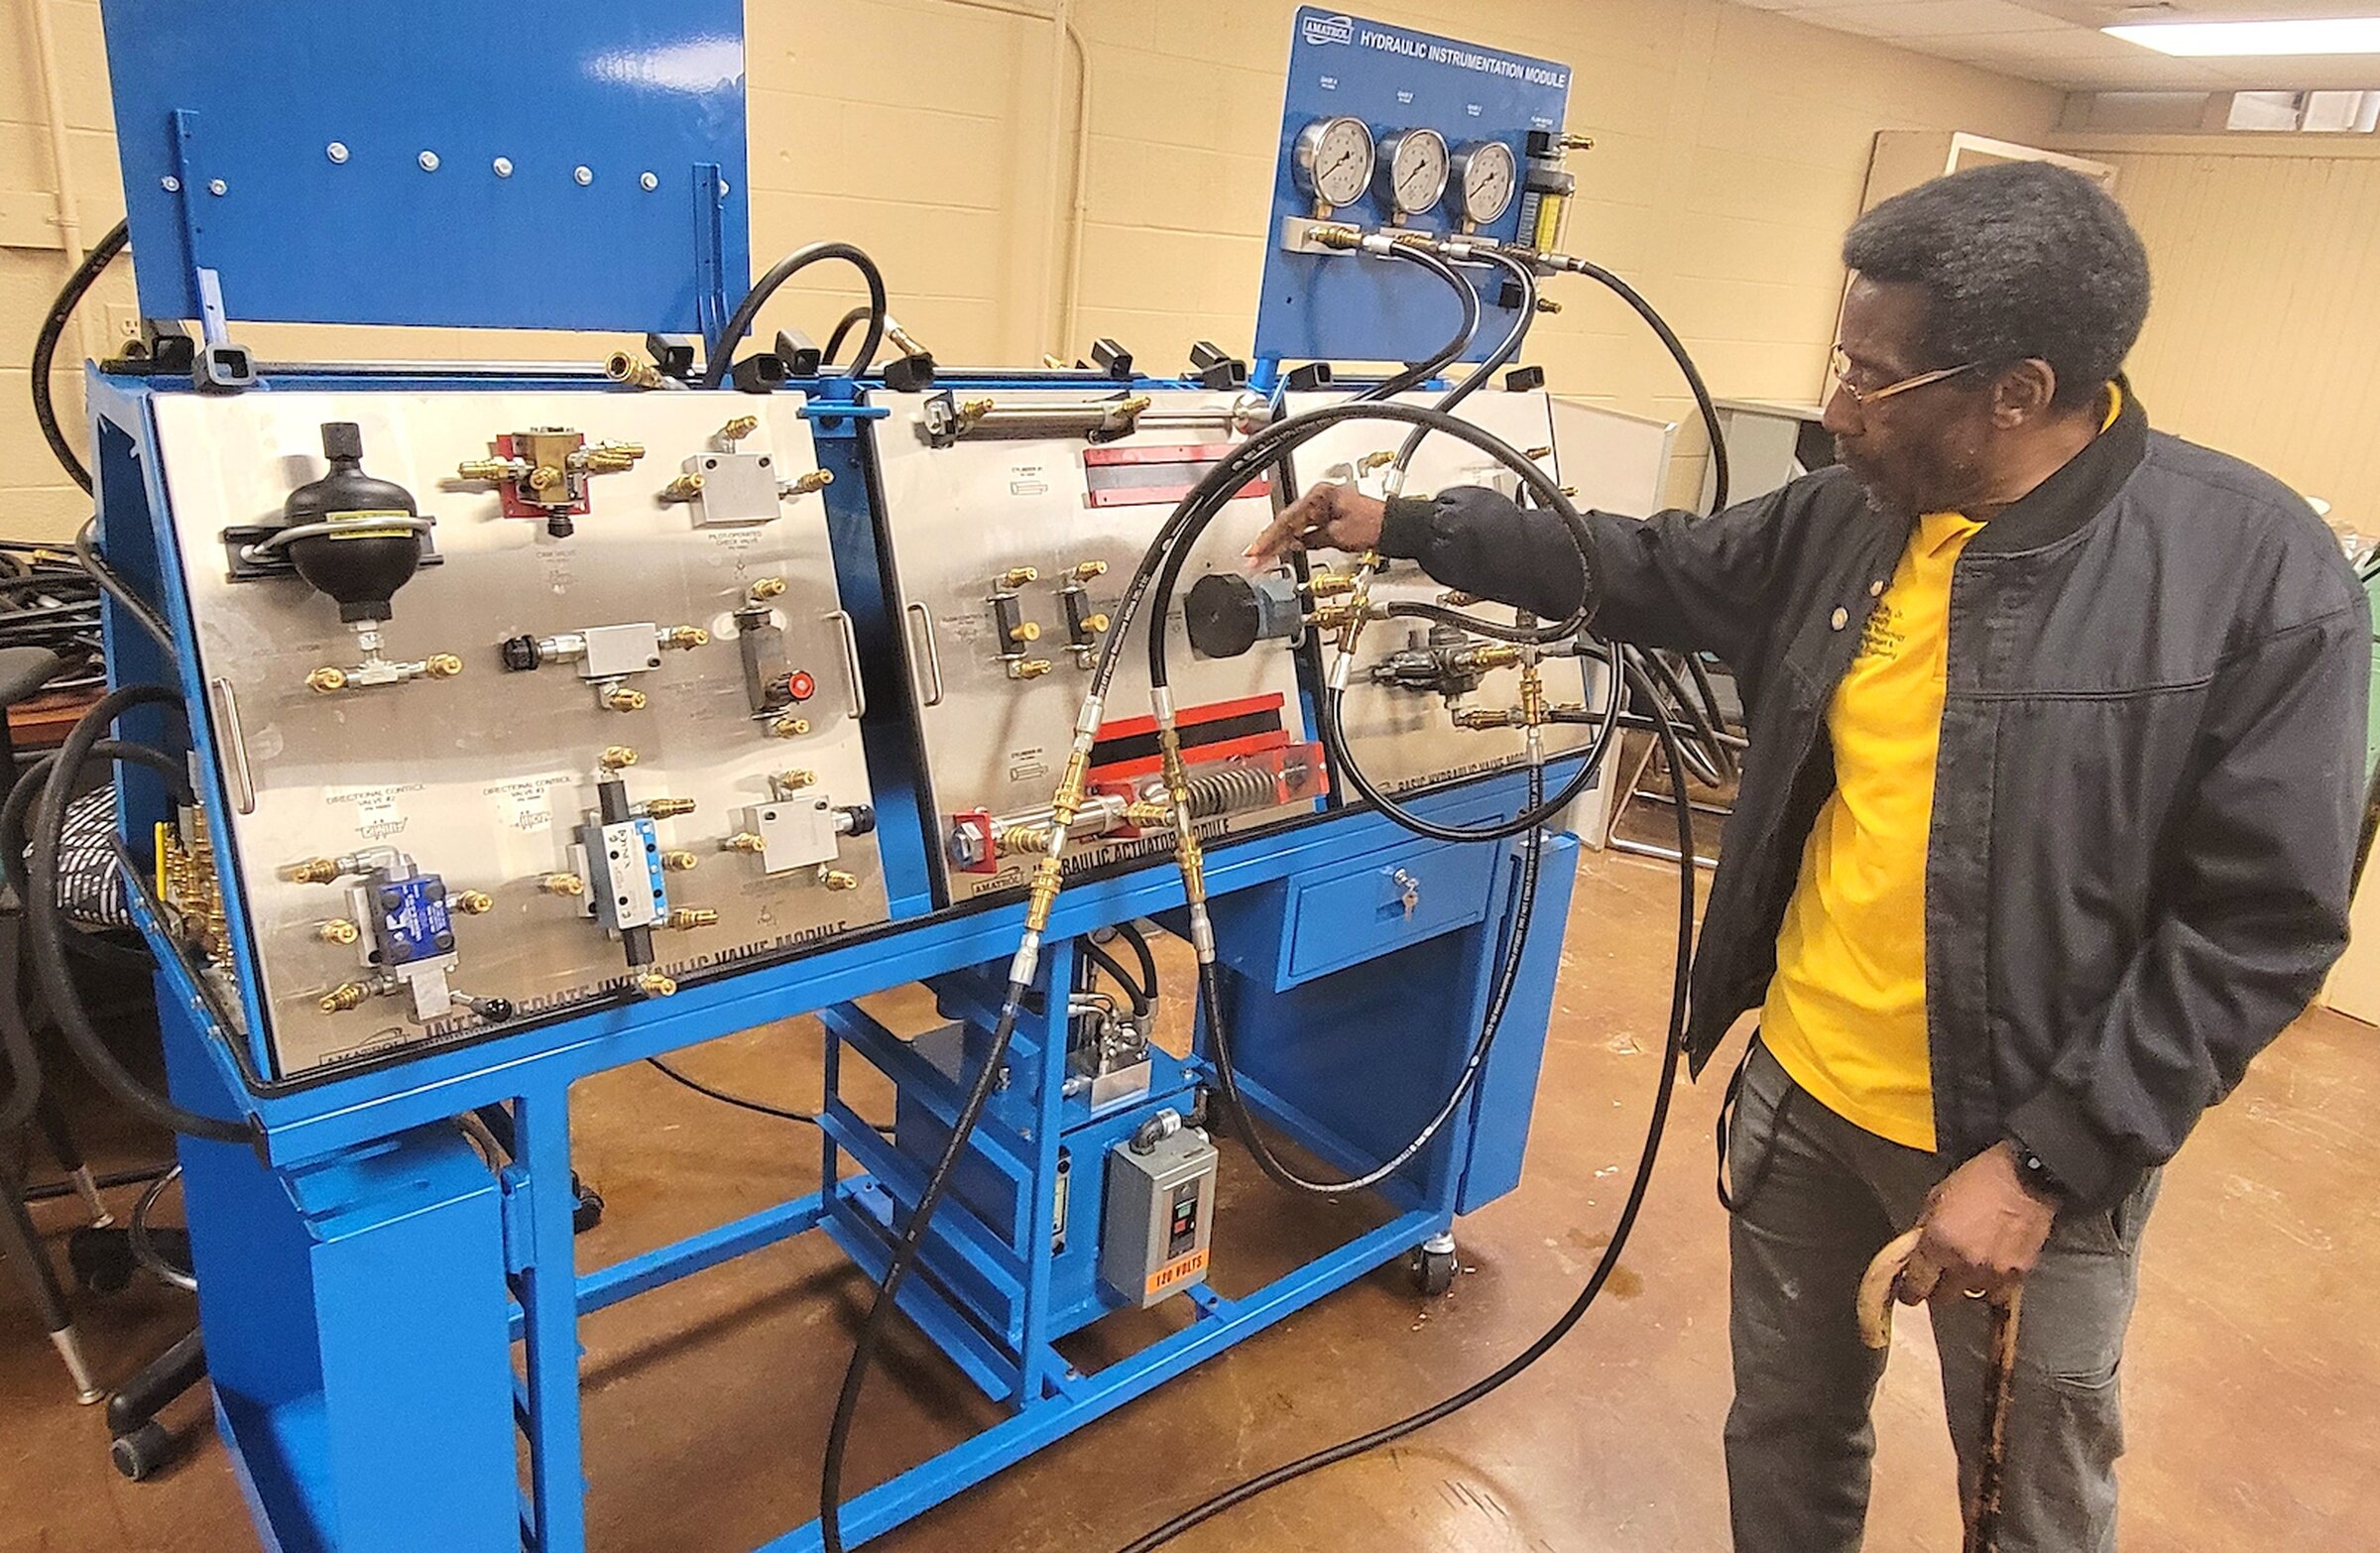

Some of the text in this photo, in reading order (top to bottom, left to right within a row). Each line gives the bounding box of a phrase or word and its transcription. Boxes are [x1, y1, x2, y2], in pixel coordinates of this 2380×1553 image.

[1304, 20, 1350, 42] AMATROL
[1360, 30, 1567, 89] HYDRAULIC INSTRUMENTATION MODULE
[326, 783, 426, 805] DIRECTIONAL CONTROL
[483, 776, 571, 795] DIRECTIONAL CONTROL
[1114, 831, 1177, 861] ACTUATOR
[714, 938, 770, 966] VALVE
[775, 920, 847, 952] MODULE
[1156, 1254, 1203, 1288] 120 VOLTS
